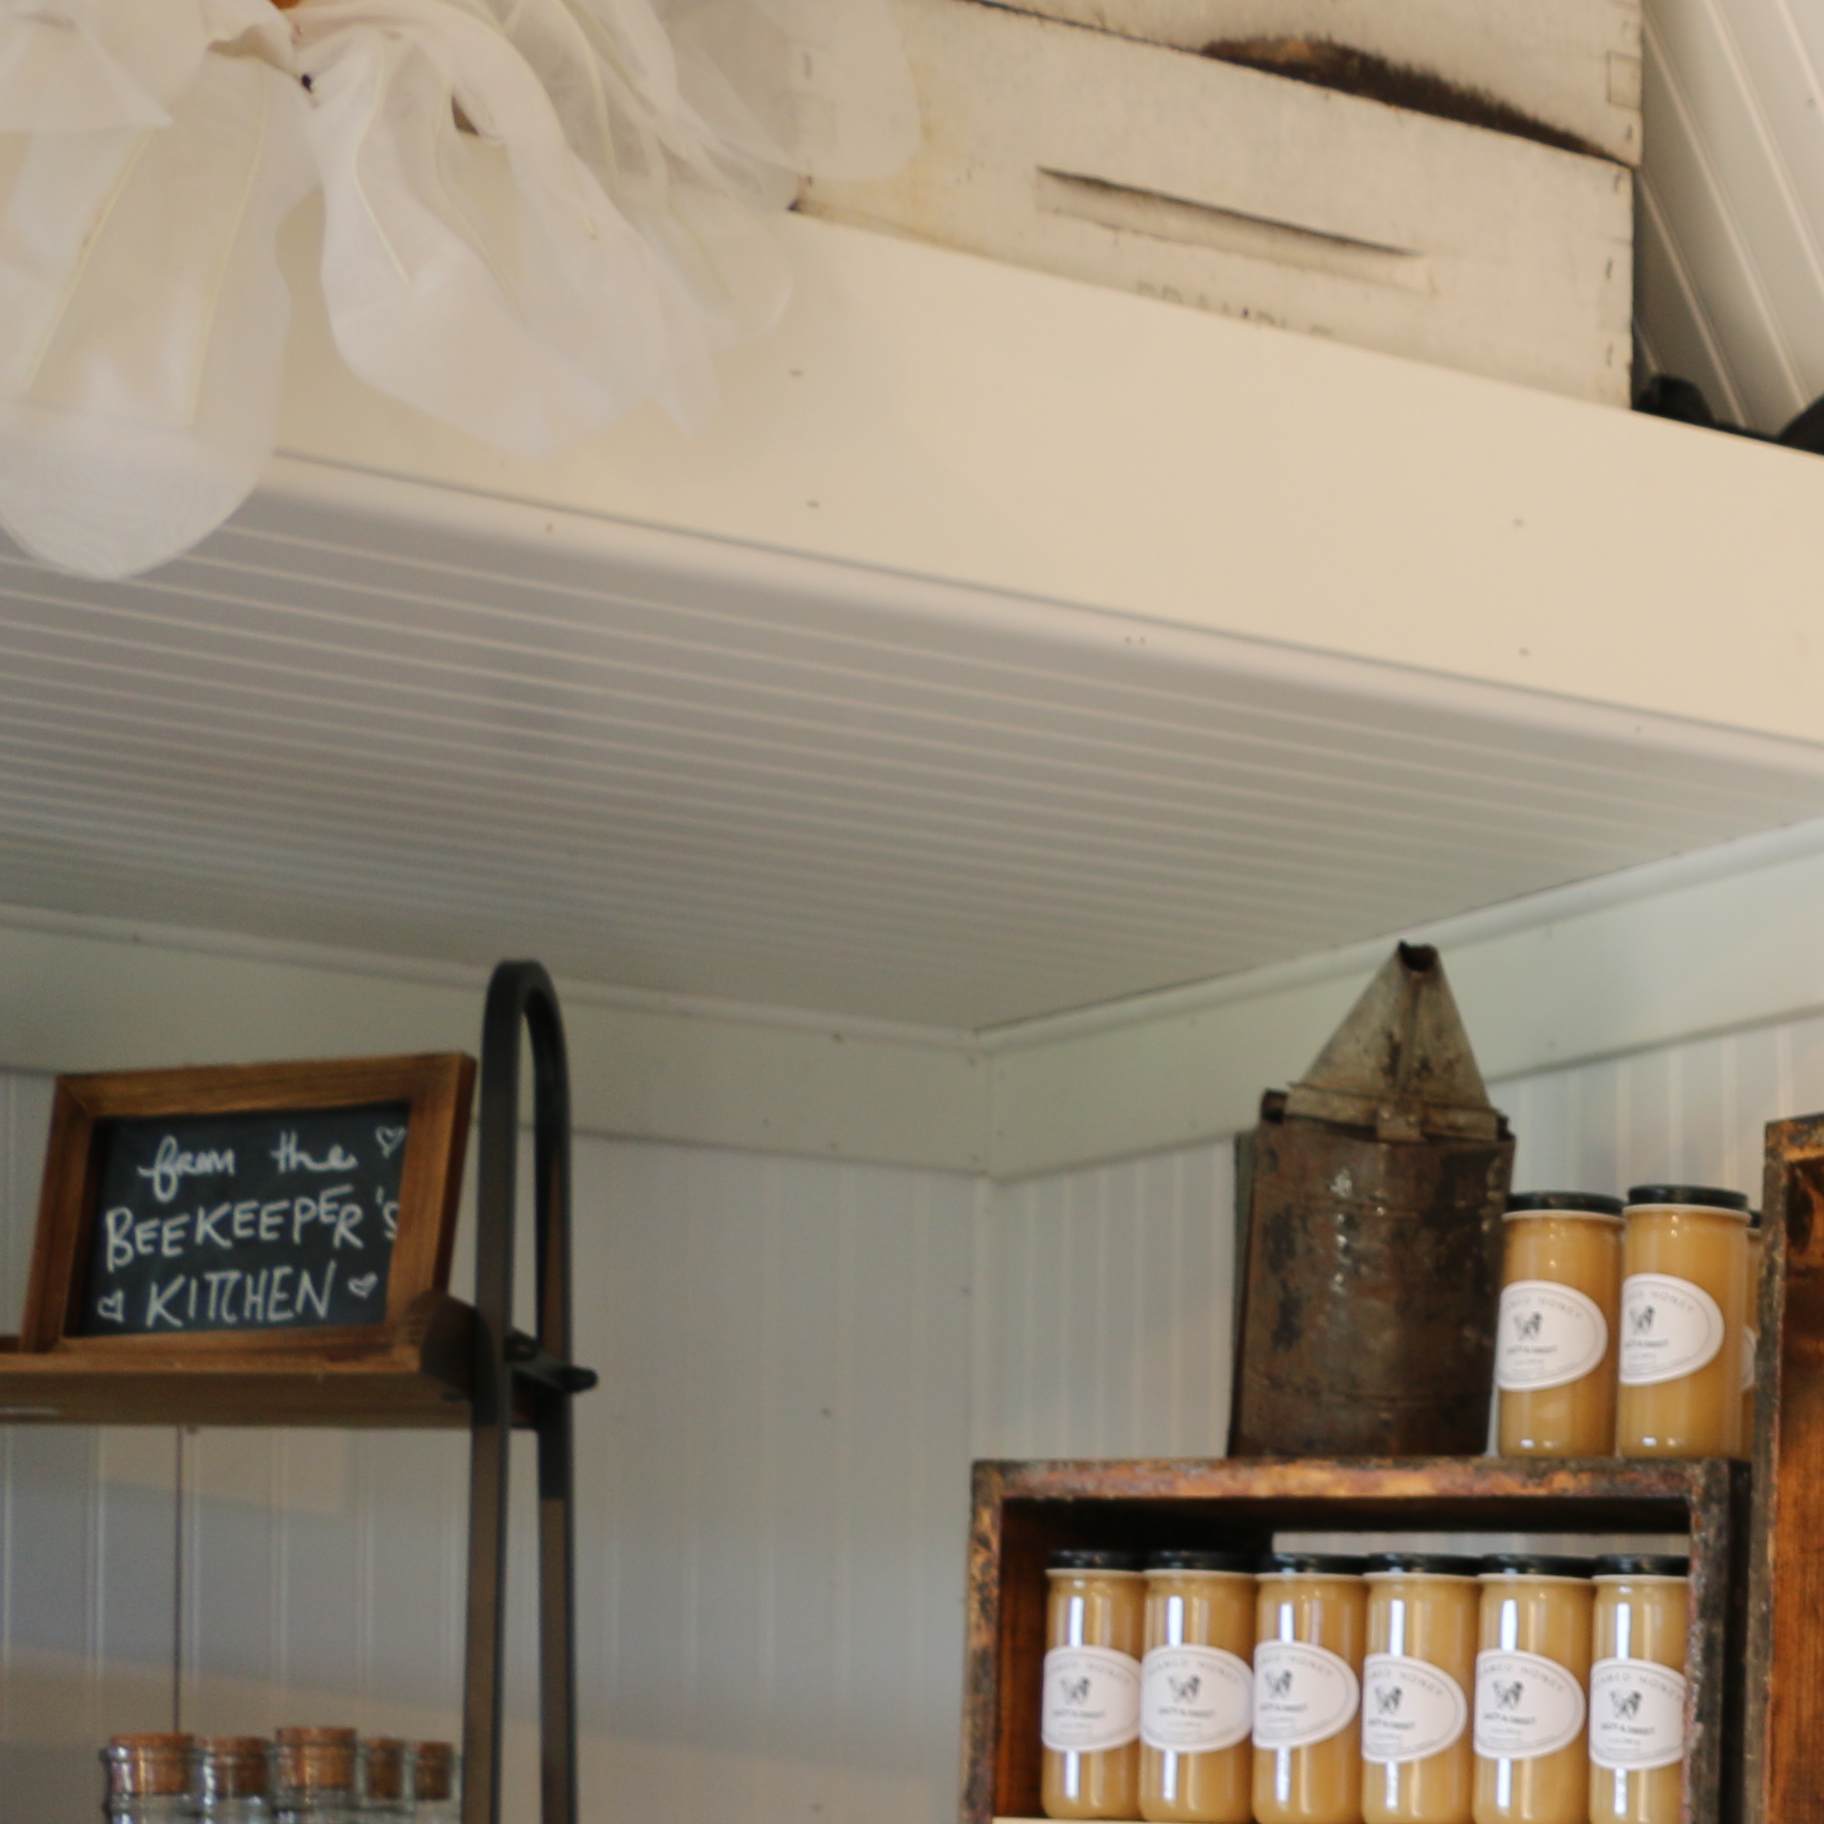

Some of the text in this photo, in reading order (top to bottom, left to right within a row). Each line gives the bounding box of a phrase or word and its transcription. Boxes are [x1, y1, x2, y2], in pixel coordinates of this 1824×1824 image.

[137, 1130, 359, 1203] from the
[146, 1259, 337, 1328] KITCHEN
